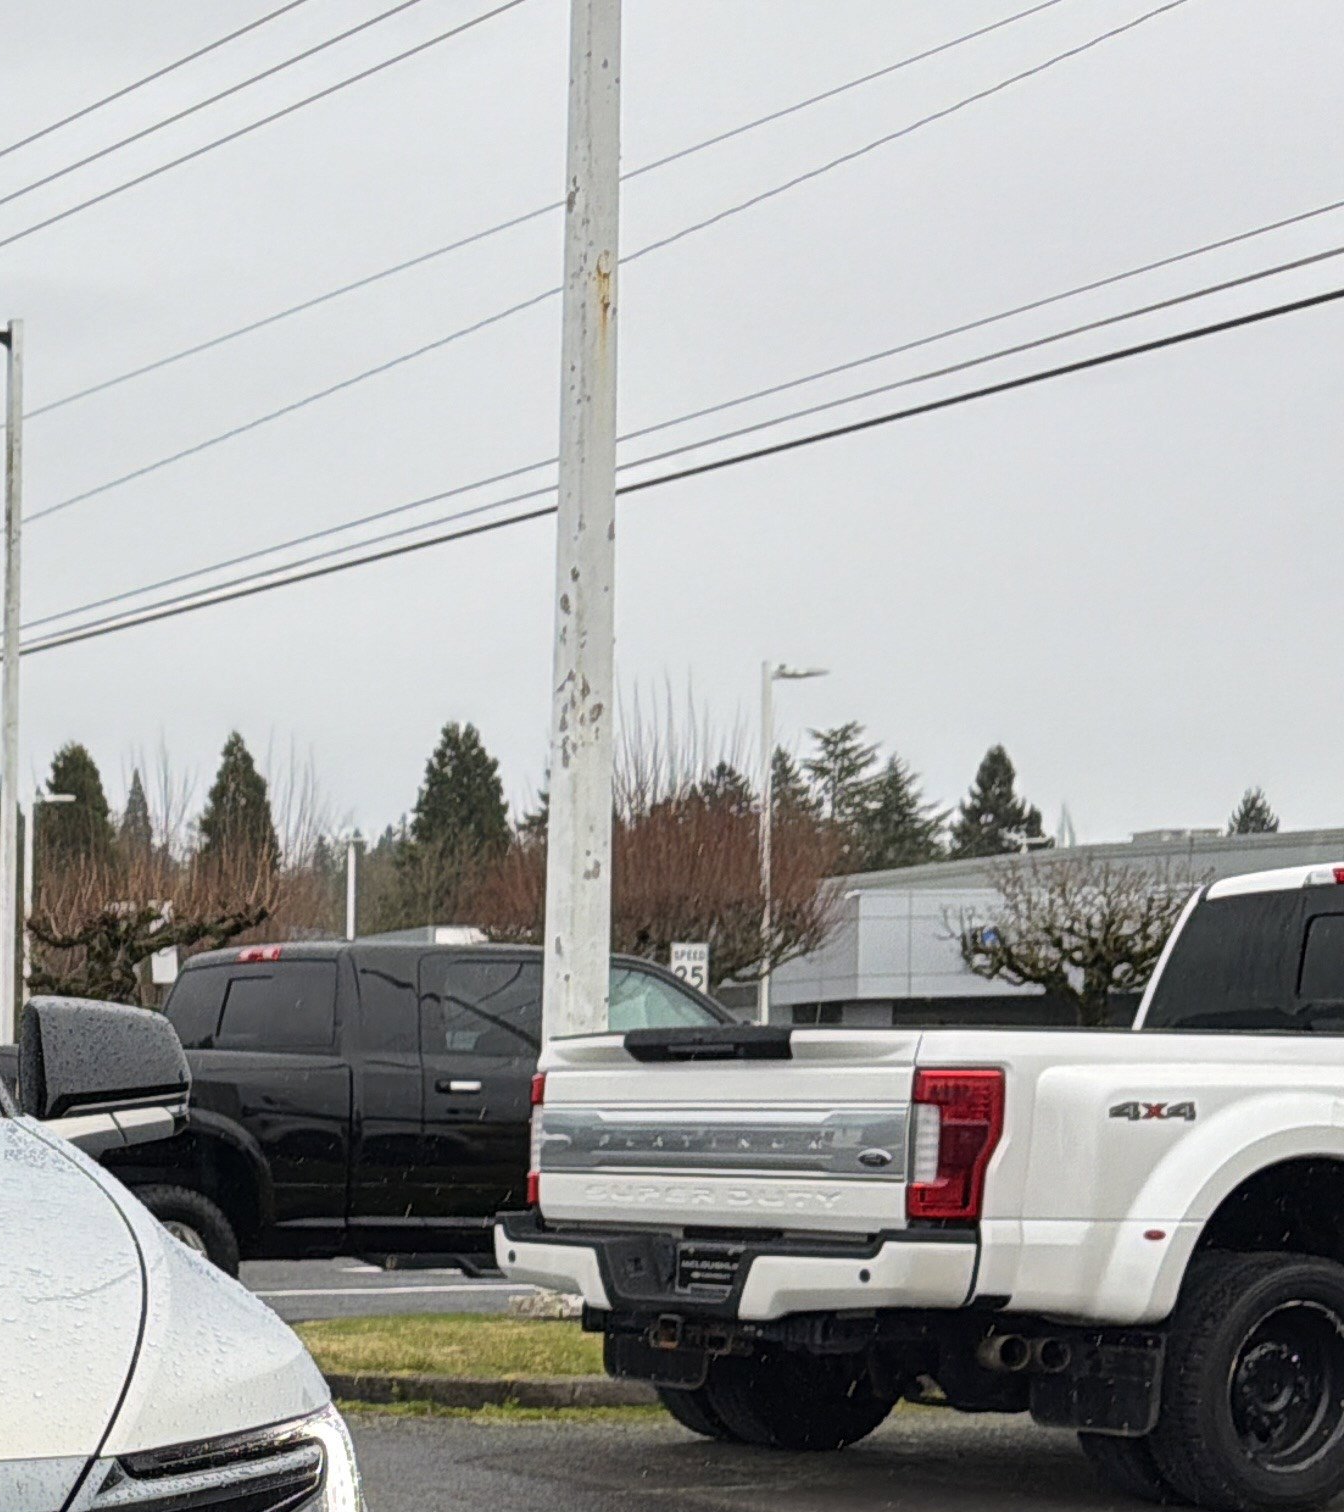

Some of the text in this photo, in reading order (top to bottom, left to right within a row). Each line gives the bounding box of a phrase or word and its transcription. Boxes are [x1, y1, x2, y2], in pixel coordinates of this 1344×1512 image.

[675, 965, 704, 989] 25
[584, 1183, 842, 1209] SUPER DUTY
